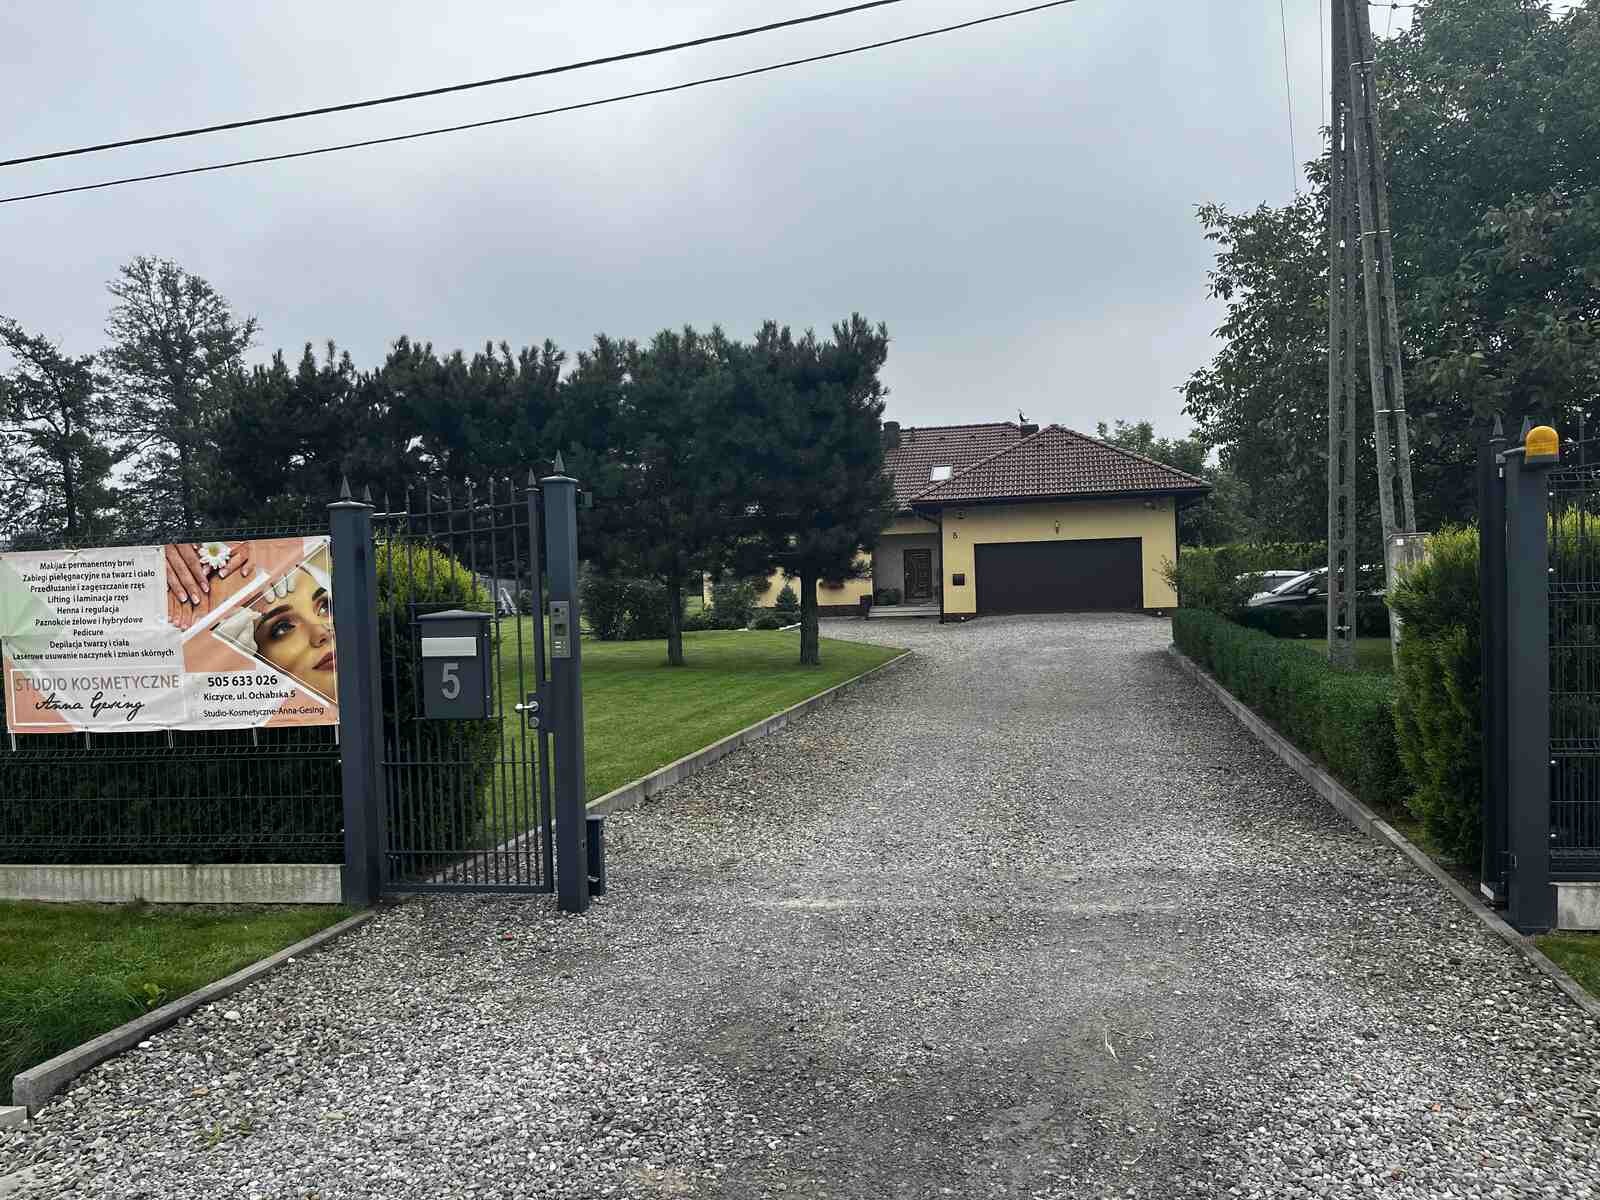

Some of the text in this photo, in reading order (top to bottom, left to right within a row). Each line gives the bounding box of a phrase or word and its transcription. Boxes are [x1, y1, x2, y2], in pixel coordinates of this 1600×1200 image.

[68, 560, 116, 569] permanentny
[118, 559, 134, 567] brwi
[23, 574, 48, 582] Zabiegi
[49, 572, 100, 581] pielęgnacyjne
[112, 570, 132, 578] twarz
[138, 569, 155, 577] ciało
[81, 583, 128, 592] zagęszczanie
[48, 596, 70, 604] Lifting
[77, 595, 113, 603] laminacja
[114, 594, 129, 602] rzęs
[85, 606, 120, 615] regulacja
[35, 618, 70, 626] Paznokcie
[102, 616, 143, 625] hybrydowe
[50, 640, 82, 649] Depilacja
[84, 640, 107, 648] twarzy
[79, 651, 112, 660] naczynek
[118, 650, 139, 658] zmian
[141, 649, 174, 658] skórnych
[16, 675, 179, 691] STUDIO KOSMETYCZNE
[208, 675, 278, 687] 505 633 026
[442, 662, 460, 699] 5
[204, 692, 235, 702] Kiczyce,
[237, 691, 247, 700] ul.
[290, 690, 296, 698] 5
[35, 690, 145, 721] Anna Gesing
